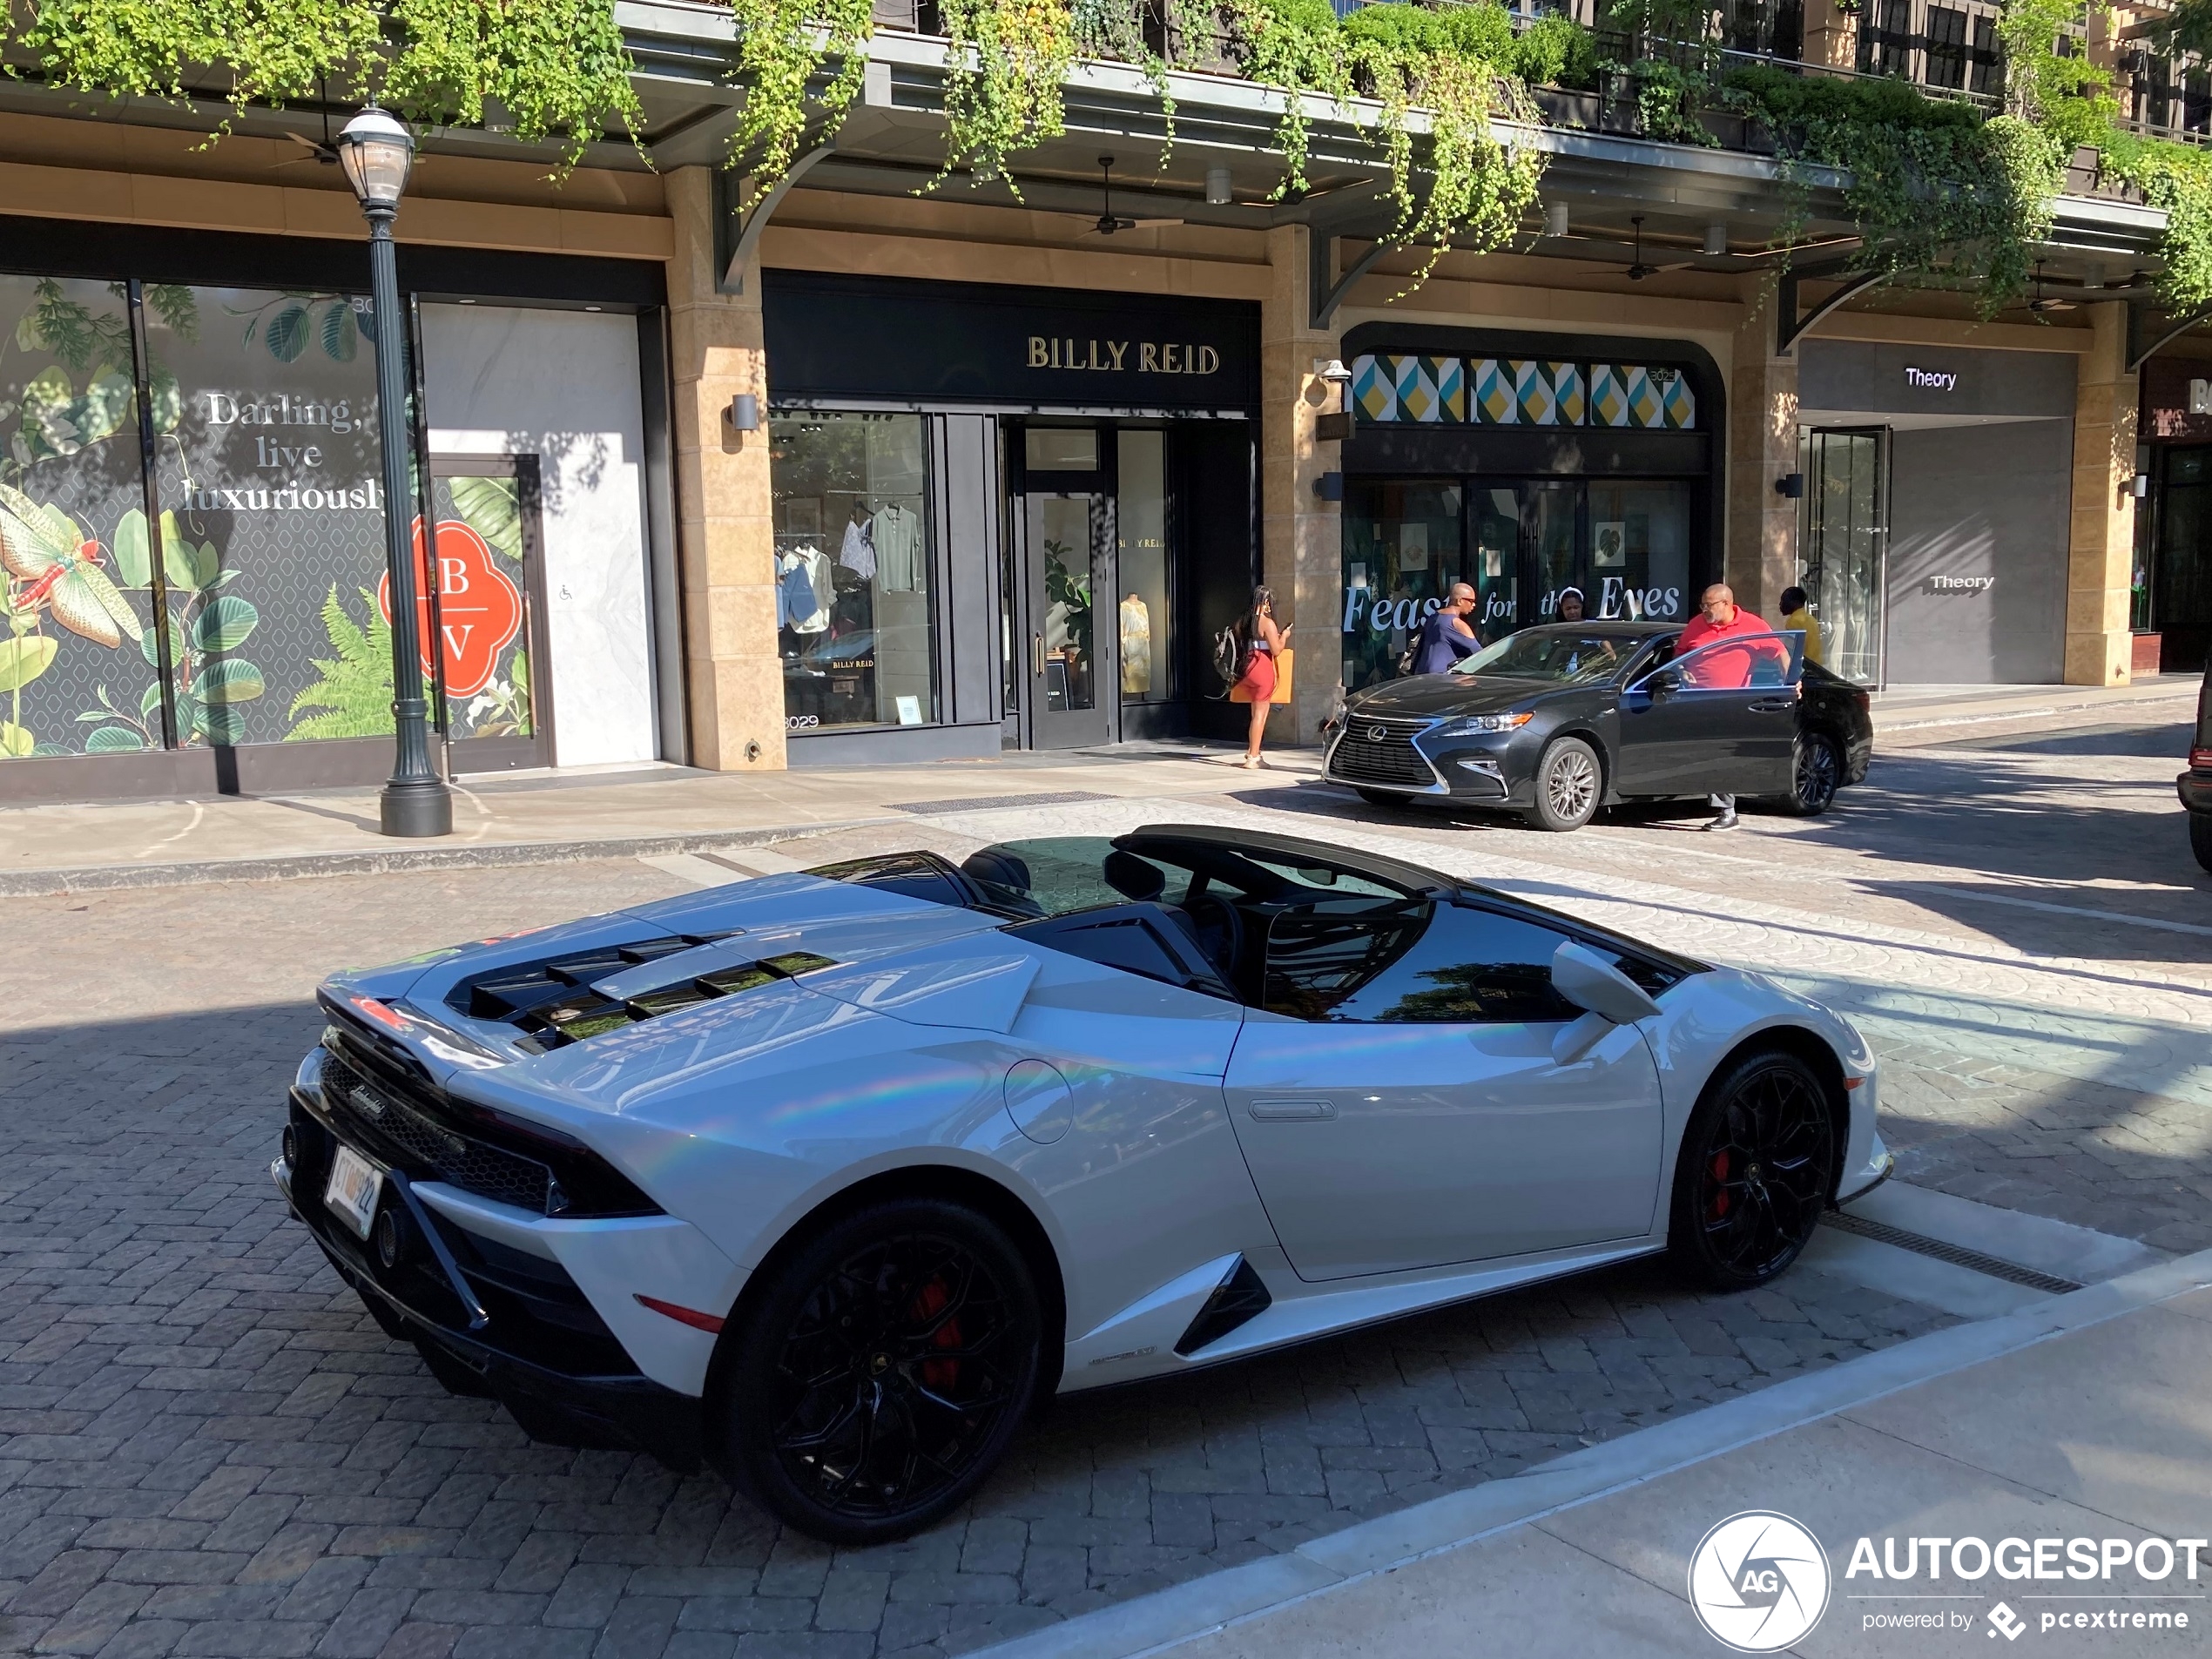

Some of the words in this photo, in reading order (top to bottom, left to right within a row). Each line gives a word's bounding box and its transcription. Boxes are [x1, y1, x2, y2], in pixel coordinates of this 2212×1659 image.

[1026, 336, 1130, 371] BILLY
[1138, 341, 1220, 374] REID
[1650, 370, 1675, 381] 3025
[1905, 368, 1957, 392] Theory
[206, 394, 361, 434] Darling,
[255, 435, 322, 468] live
[439, 558, 469, 594] B
[1930, 575, 1995, 590] Theory
[1343, 586, 1450, 632] Feas
[1481, 591, 1517, 624] for
[1541, 590, 1560, 616] th
[1595, 577, 1680, 622] Eyes
[442, 624, 475, 662] V
[833, 660, 854, 669] BILLY
[856, 659, 874, 668] REID
